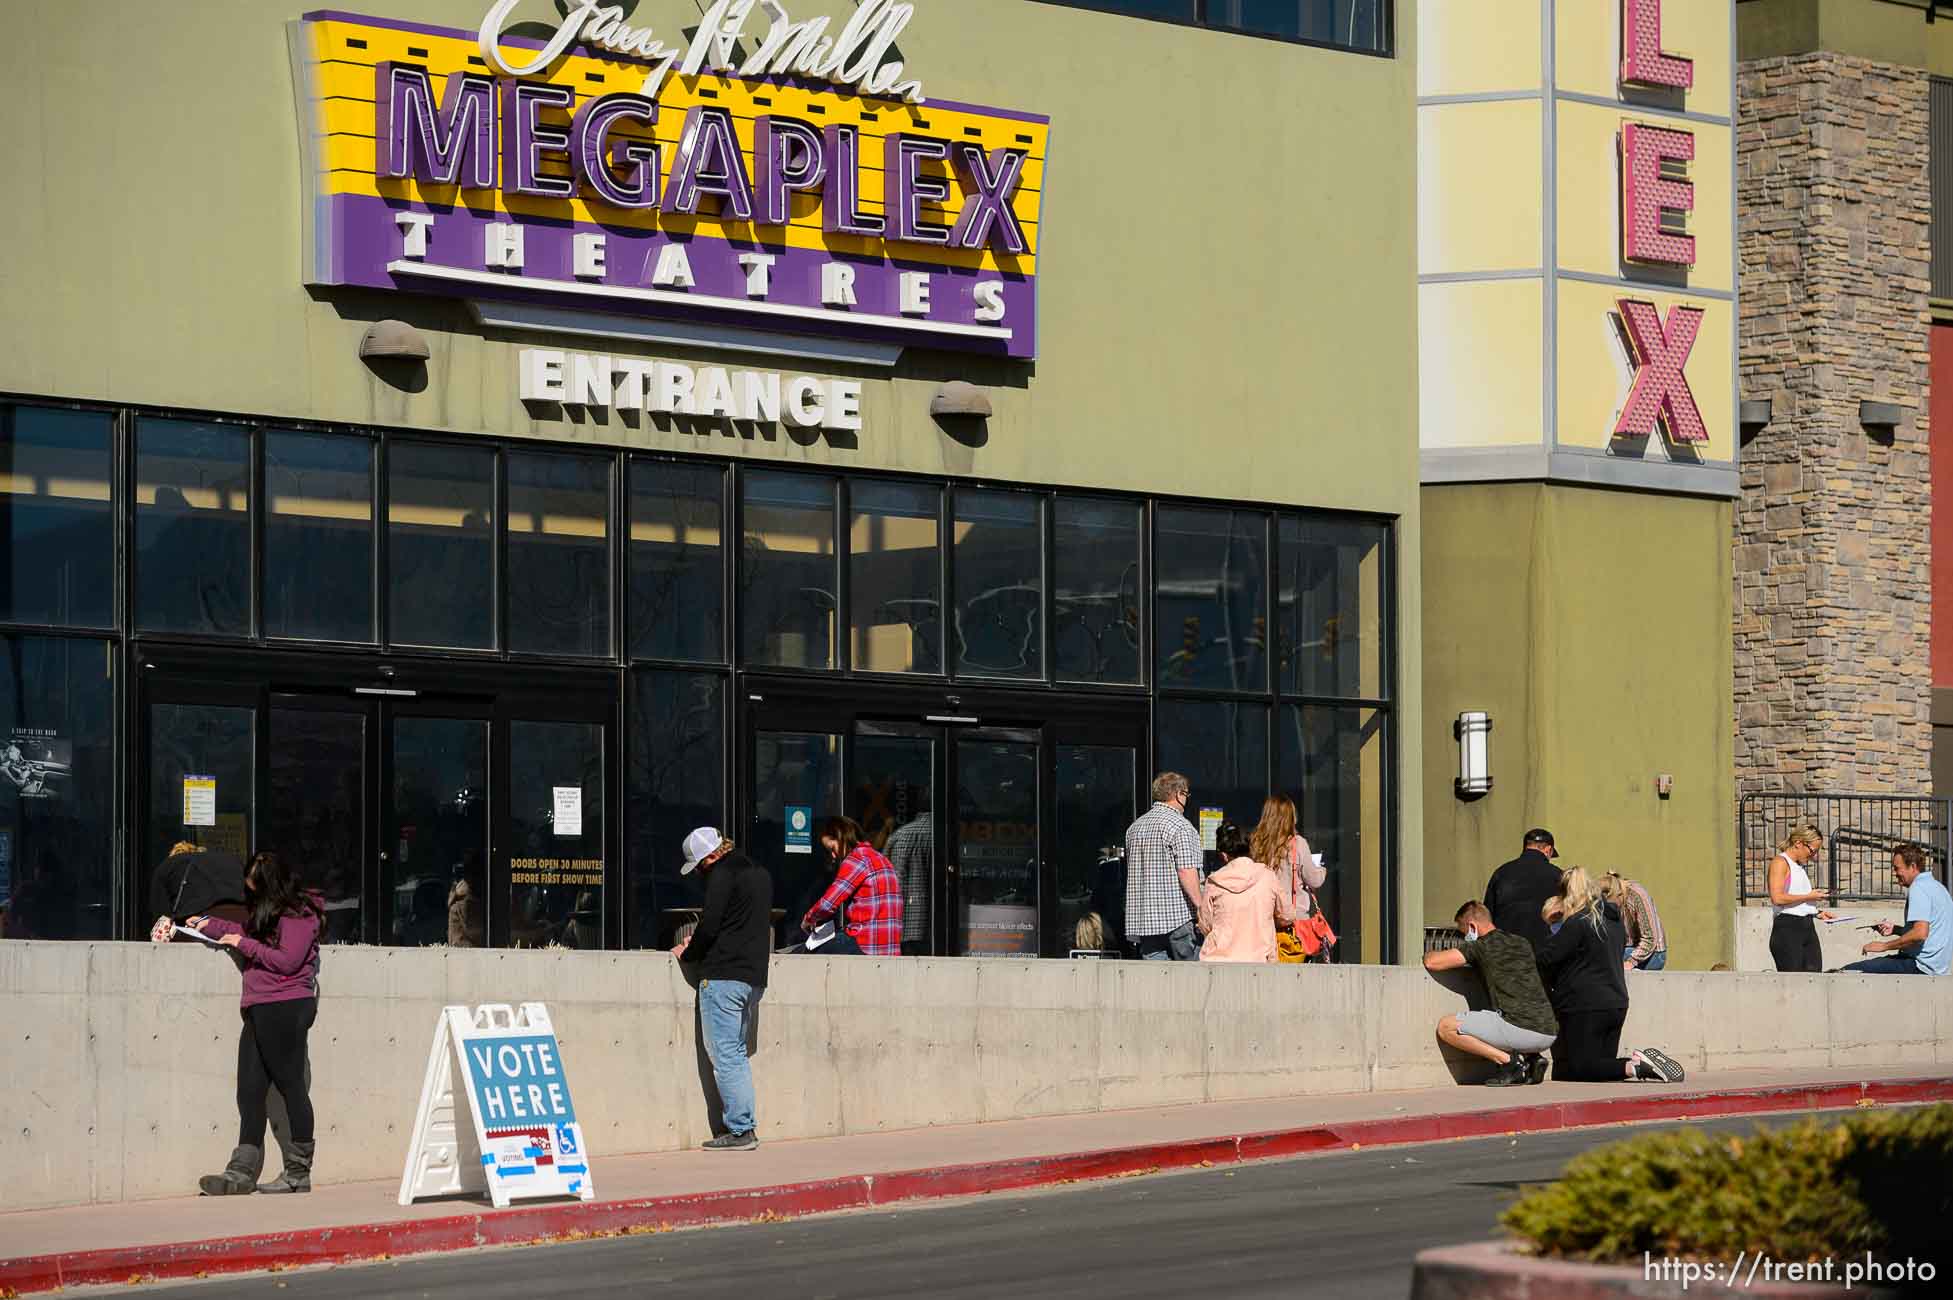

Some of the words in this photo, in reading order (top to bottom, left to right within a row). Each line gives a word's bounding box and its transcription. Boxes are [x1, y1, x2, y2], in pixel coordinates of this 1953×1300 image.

[376, 60, 1030, 256] MEGAPLEX
[395, 211, 1007, 324] THEATRES
[519, 348, 863, 432] ENTRANCE
[511, 858, 537, 869] DOORS
[539, 858, 559, 869] OPEN
[561, 859, 570, 870] 30
[571, 859, 603, 870] MINUTES
[511, 872, 540, 884] BEFORE
[541, 872, 560, 885] FIRST
[562, 873, 584, 885] SHOW
[586, 874, 603, 885] TIME
[472, 1043, 557, 1079] VOTE
[484, 1082, 567, 1120] HERE
